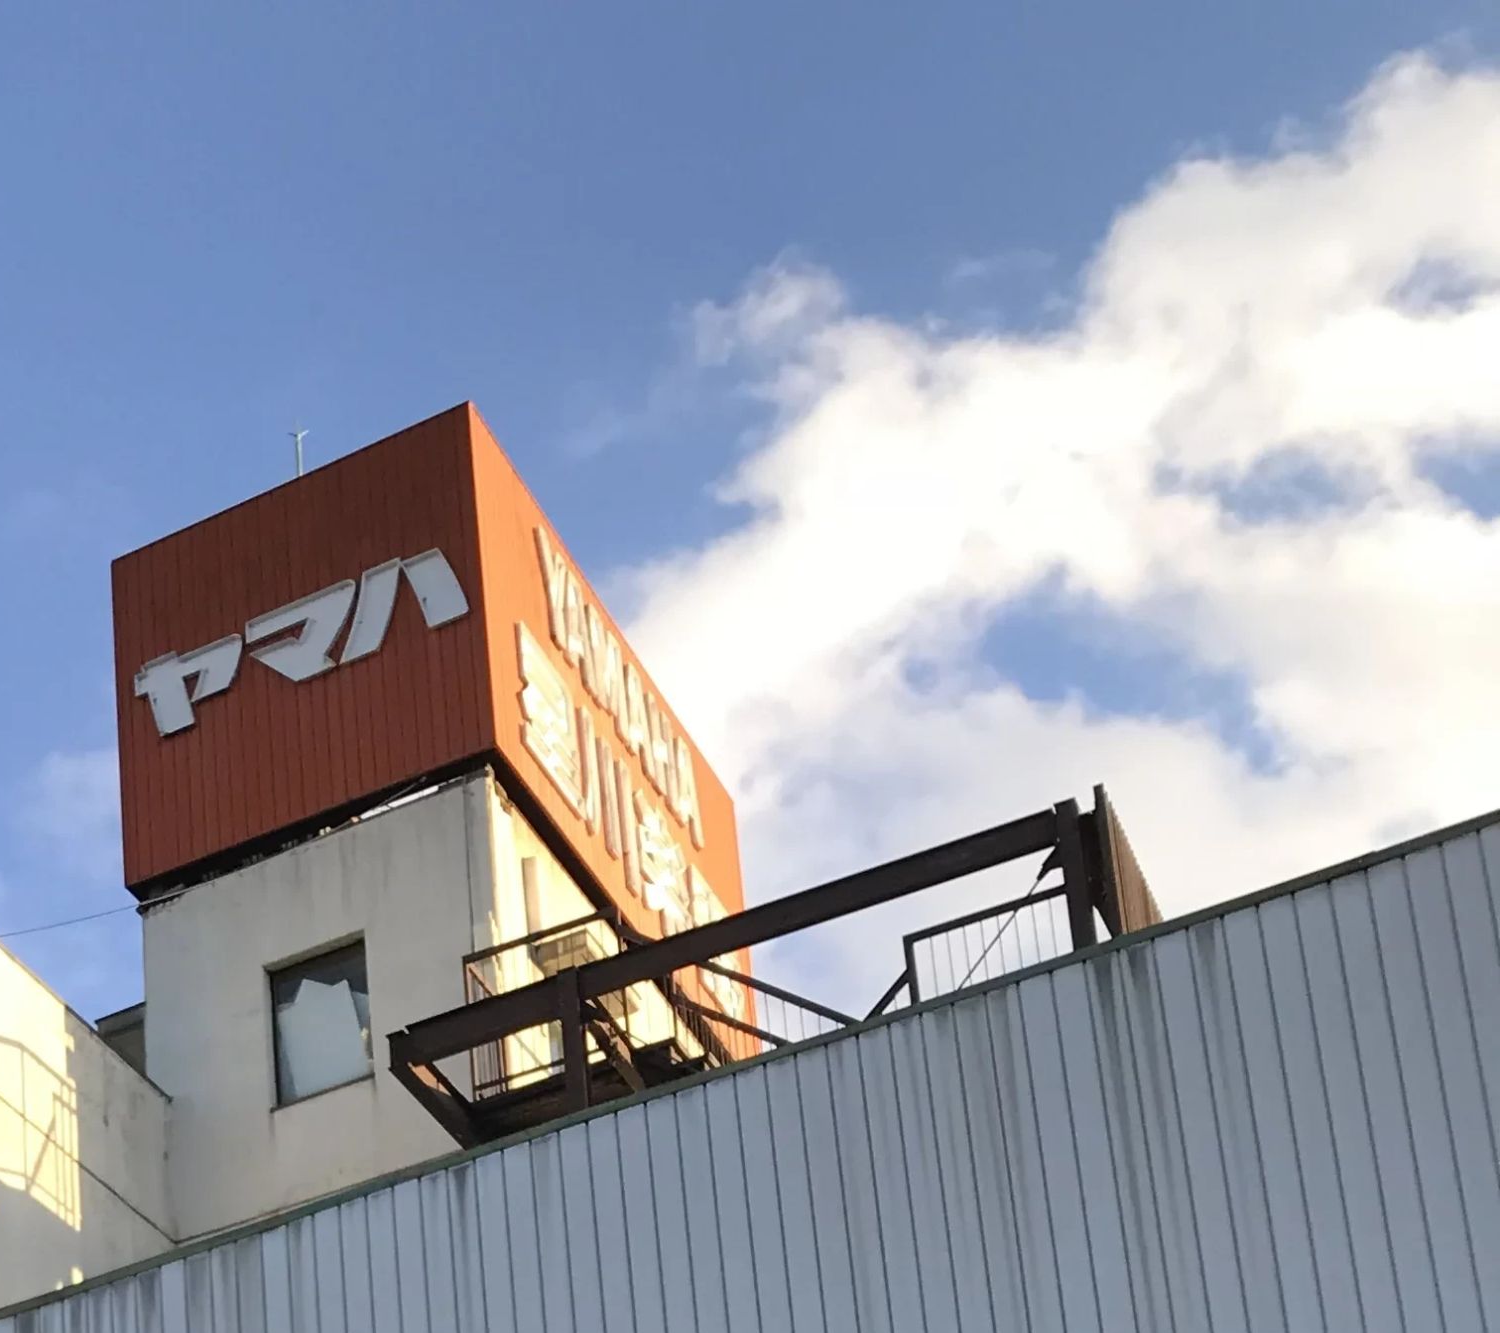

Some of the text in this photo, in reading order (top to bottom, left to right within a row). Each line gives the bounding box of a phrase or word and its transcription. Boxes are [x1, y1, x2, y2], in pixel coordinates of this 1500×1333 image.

[134, 547, 471, 737] ヤマハ
[532, 523, 705, 851] YAMAHA
